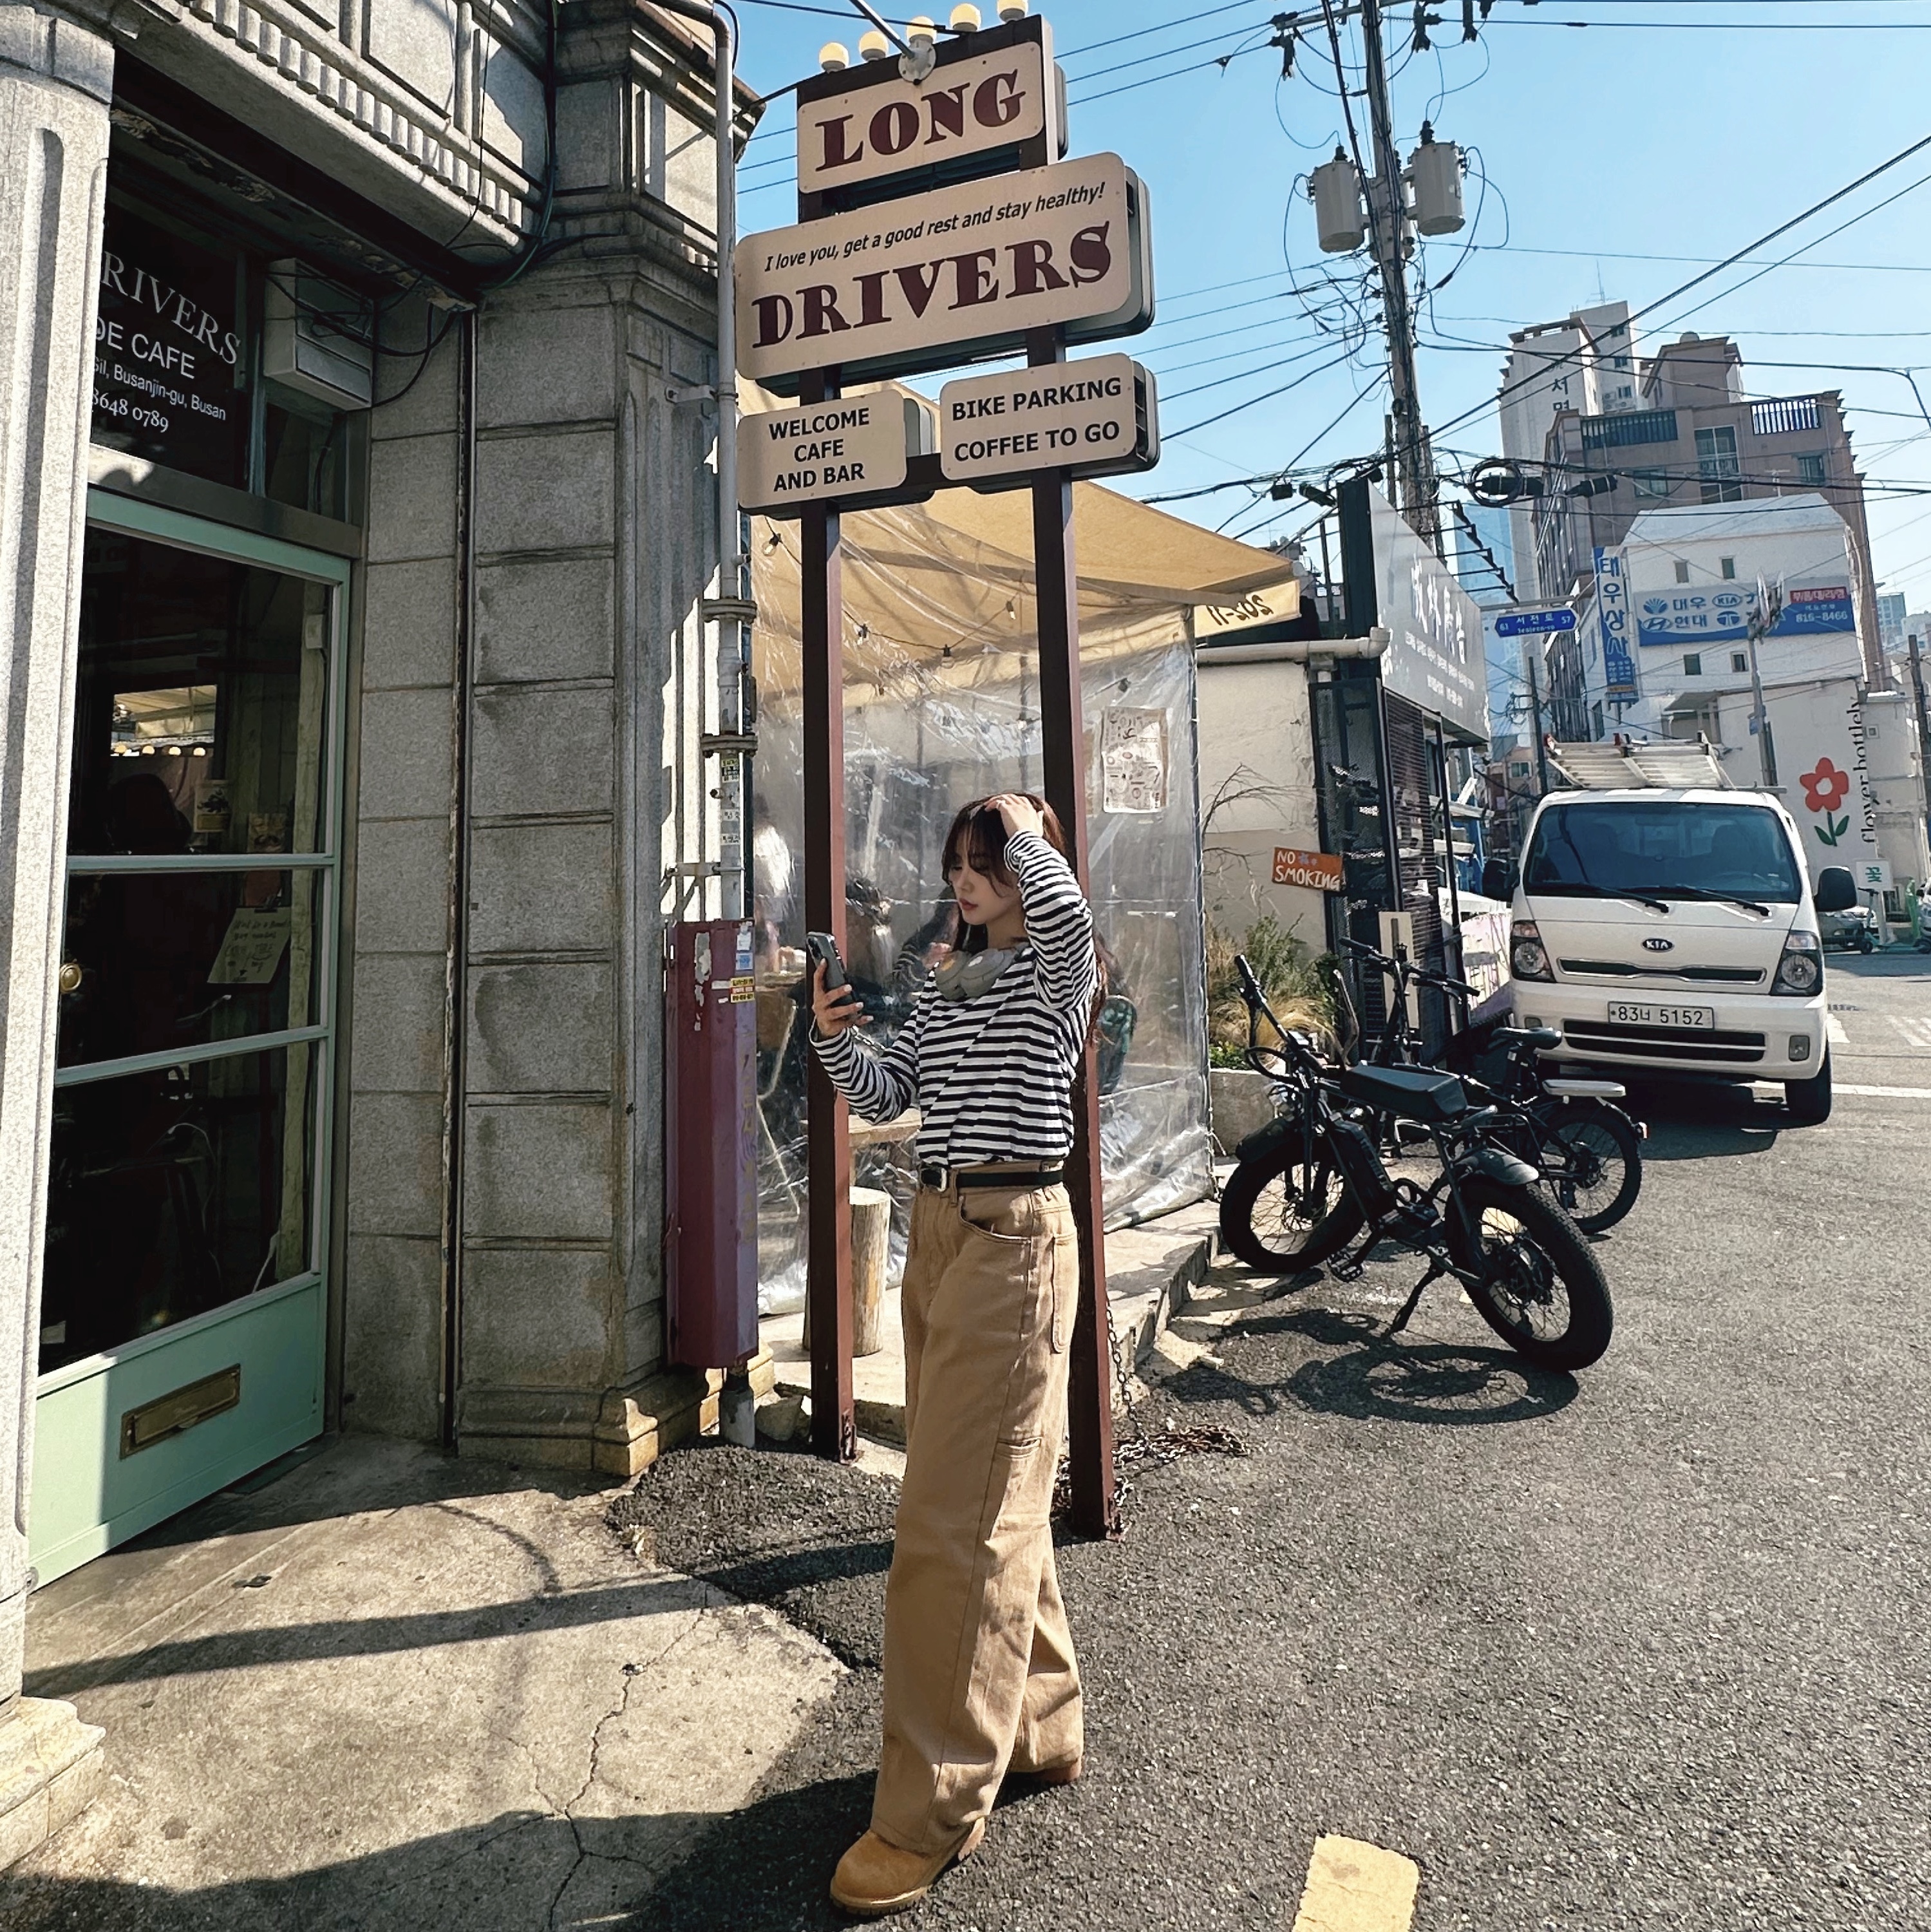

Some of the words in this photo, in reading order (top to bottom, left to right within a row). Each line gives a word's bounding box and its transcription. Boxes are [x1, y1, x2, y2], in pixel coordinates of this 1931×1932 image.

[815, 69, 1026, 172] LONG
[765, 256, 773, 272] I
[775, 252, 805, 270] love
[809, 245, 839, 266] you,
[843, 234, 869, 258] get
[871, 234, 881, 248] a
[885, 221, 924, 249] good
[927, 214, 959, 236] rest
[961, 206, 993, 228] and
[995, 201, 1031, 220] stay
[1035, 182, 1106, 212] healthy!
[752, 220, 1111, 348] DRIVERS
[101, 251, 242, 365] RIVERS
[131, 333, 196, 379] CAFE
[113, 363, 187, 408] Busanjin-gu,
[191, 393, 226, 421] Busan
[952, 395, 1006, 421] BIKE
[1013, 377, 1122, 412] PARKING
[132, 406, 169, 433] 0789
[769, 408, 870, 440] WELCOME
[794, 439, 844, 463] CAFE
[954, 433, 1038, 462] COFFEE
[1045, 427, 1078, 449] TO
[1084, 421, 1120, 443] GO
[773, 469, 817, 492] AND
[823, 462, 865, 484] BAR
[1673, 596, 1706, 611] 대우
[1861, 774, 1876, 843] flower
[1277, 851, 1296, 864] NO
[1275, 865, 1340, 892] SMOKING
[1865, 866, 1883, 883] 꽃
[1646, 940, 1669, 949] KIA
[1618, 1006, 1650, 1021] 83너
[1660, 1009, 1704, 1026] 5152
